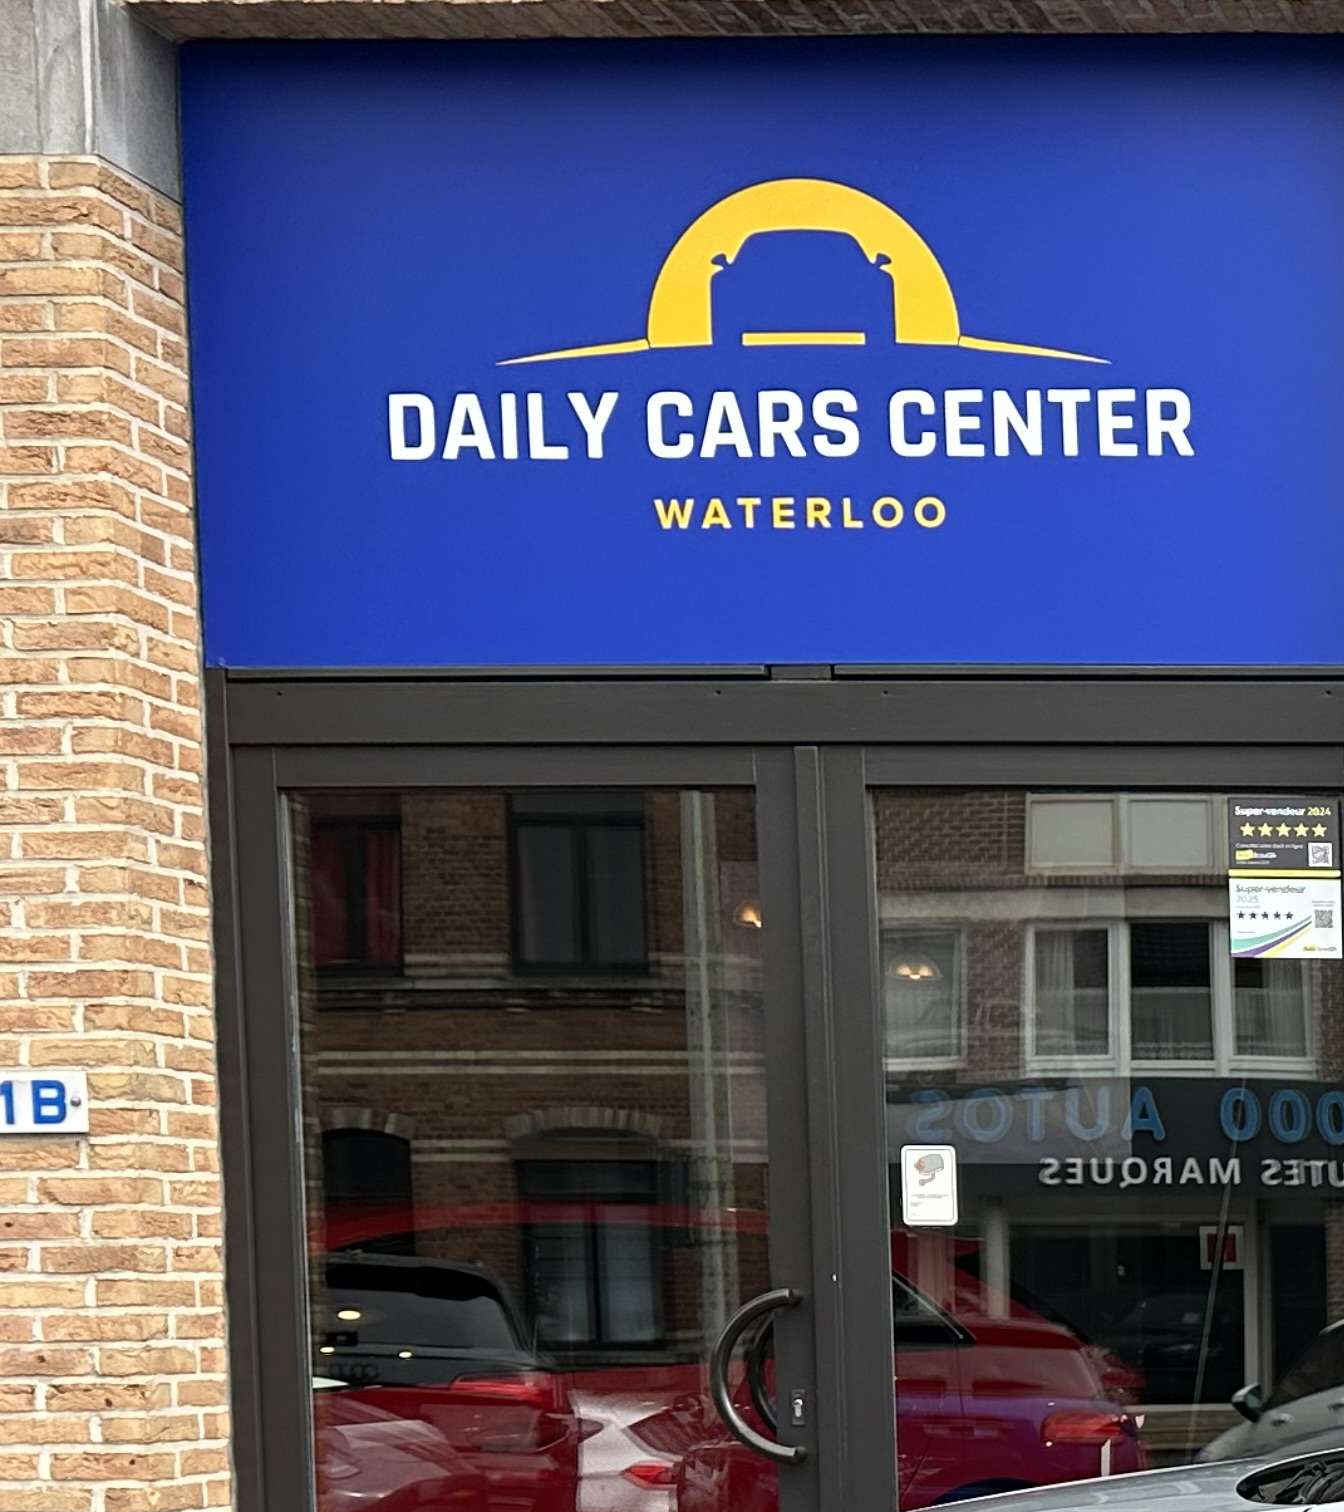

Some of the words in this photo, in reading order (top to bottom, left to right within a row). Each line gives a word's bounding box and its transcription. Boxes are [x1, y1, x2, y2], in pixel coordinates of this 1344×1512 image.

[389, 393, 618, 460] DAILY
[647, 389, 860, 458] CARS
[888, 389, 1196, 457] CENTER
[655, 497, 948, 530] WATERLOO
